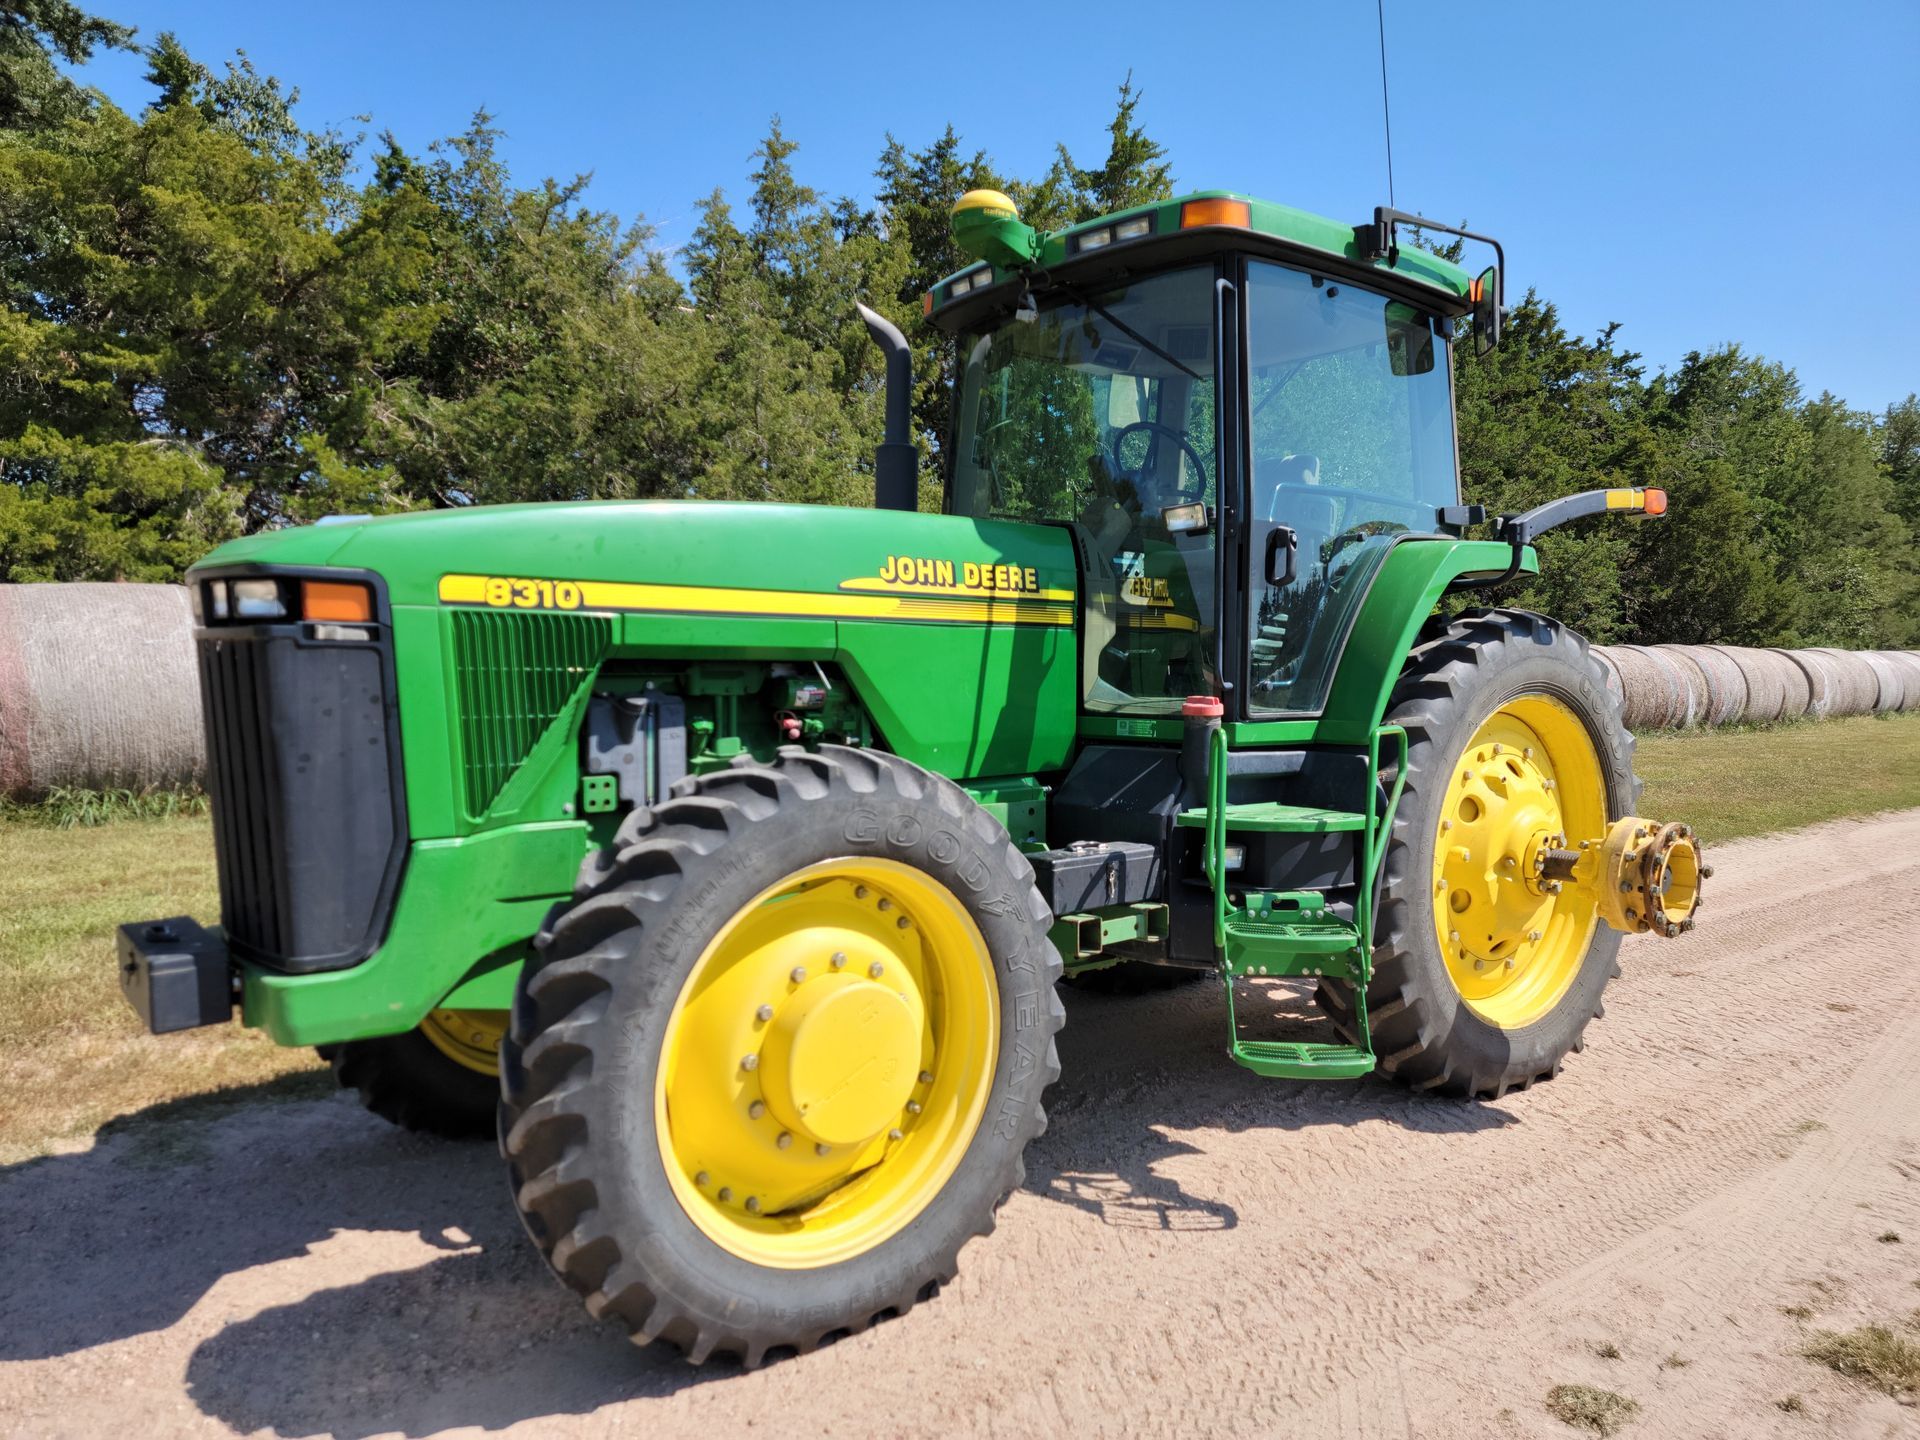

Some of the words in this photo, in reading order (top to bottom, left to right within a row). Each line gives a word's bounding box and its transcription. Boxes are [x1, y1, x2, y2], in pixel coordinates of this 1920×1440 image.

[879, 555, 955, 587] JOHN
[963, 561, 1039, 592] DEERE
[485, 577, 583, 610] 8310
[843, 806, 1041, 1143] GOODYEAR
